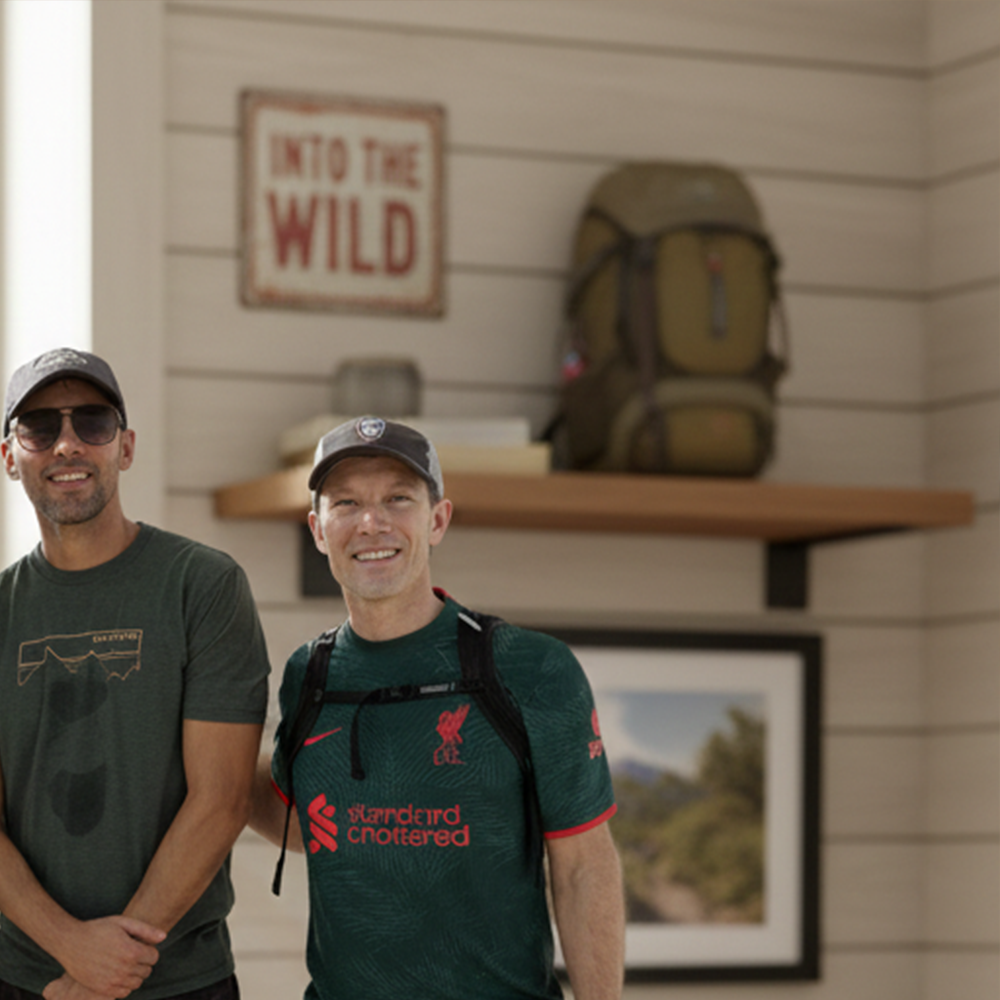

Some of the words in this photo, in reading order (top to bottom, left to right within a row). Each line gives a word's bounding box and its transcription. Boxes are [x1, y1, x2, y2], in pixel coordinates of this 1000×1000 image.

[268, 133, 348, 184] INTO
[361, 138, 421, 190] THE
[267, 189, 418, 278] WILD
